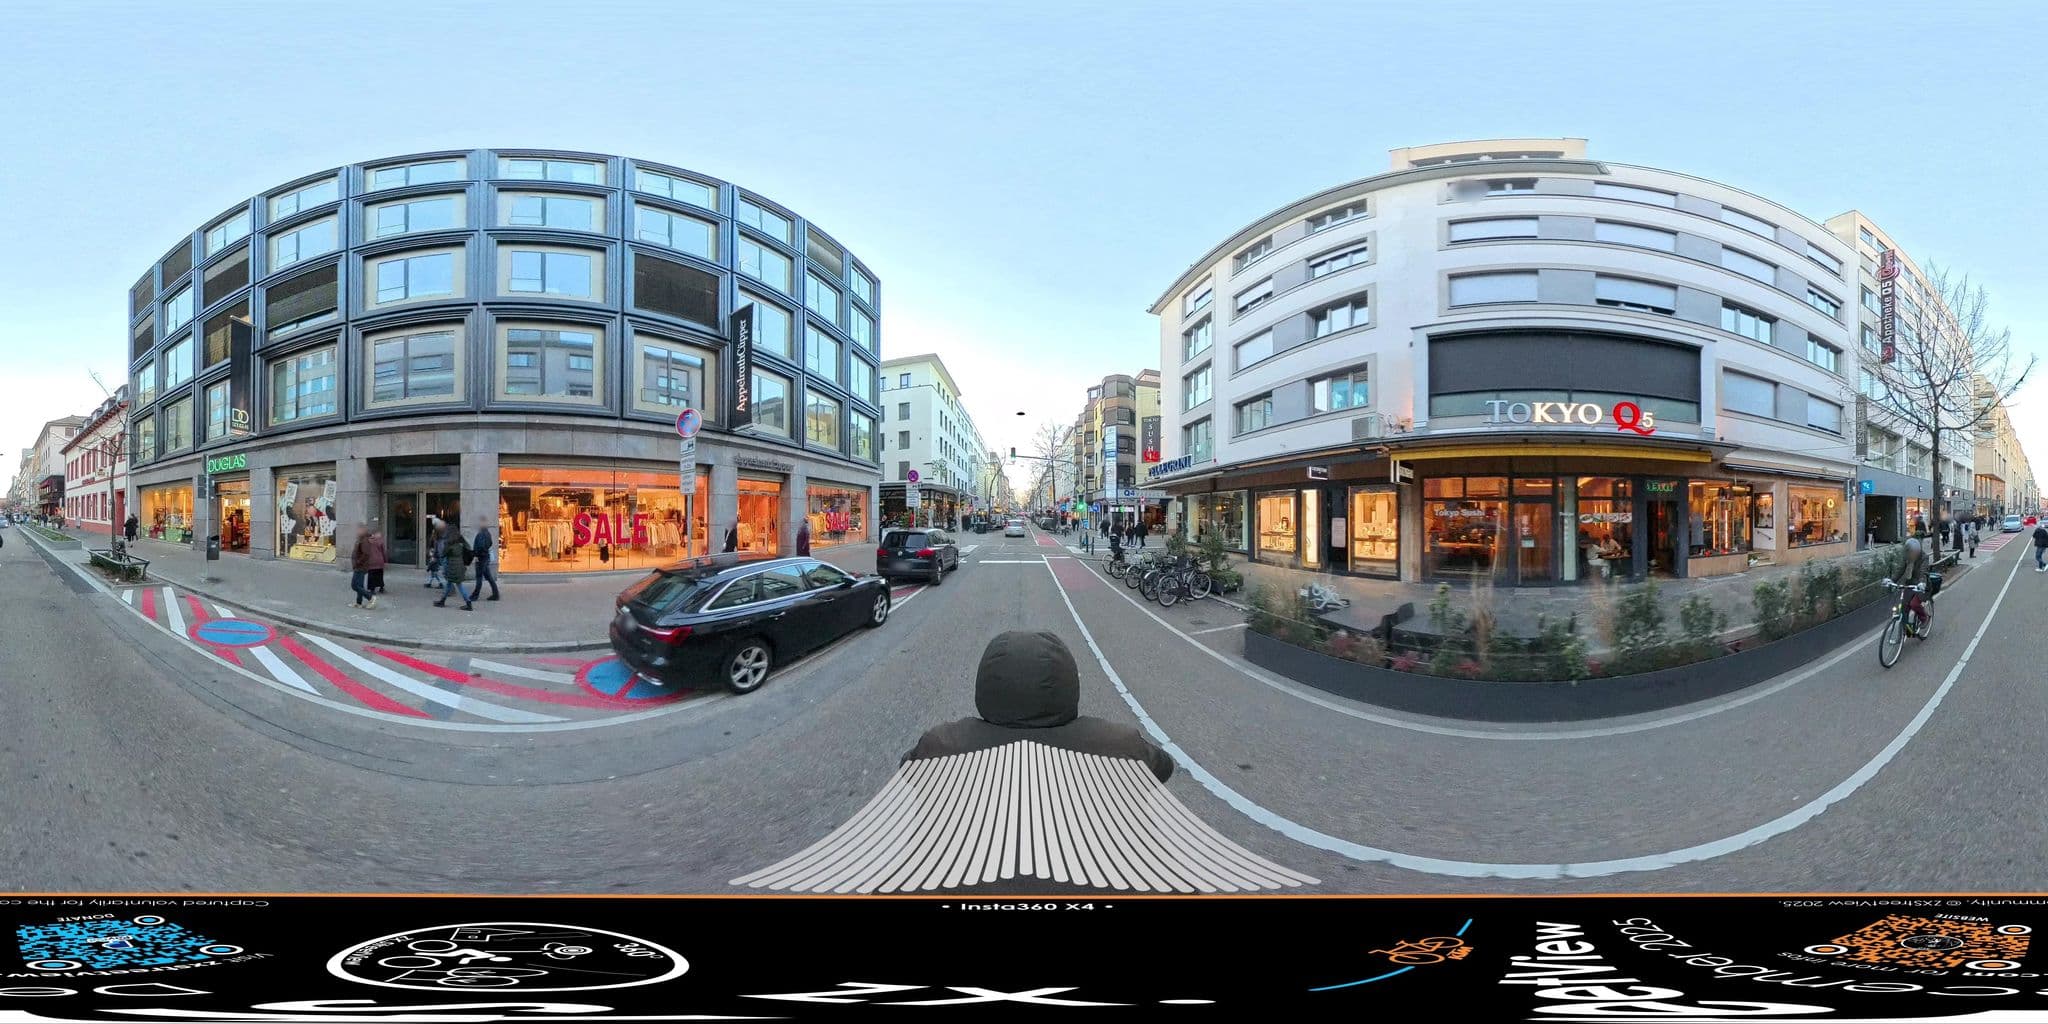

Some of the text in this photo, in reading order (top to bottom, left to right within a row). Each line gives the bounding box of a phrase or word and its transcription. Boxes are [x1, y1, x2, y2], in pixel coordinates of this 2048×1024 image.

[1882, 280, 1893, 296] Q5
[1882, 297, 1894, 344] Apotheke
[736, 319, 748, 412] AppelrathCüpper
[1485, 400, 1656, 436] TOKYO Q5
[208, 453, 246, 473] OUGLAS
[1123, 489, 1135, 497] Q4
[573, 512, 649, 548] SALE
[825, 511, 850, 532] SALE
